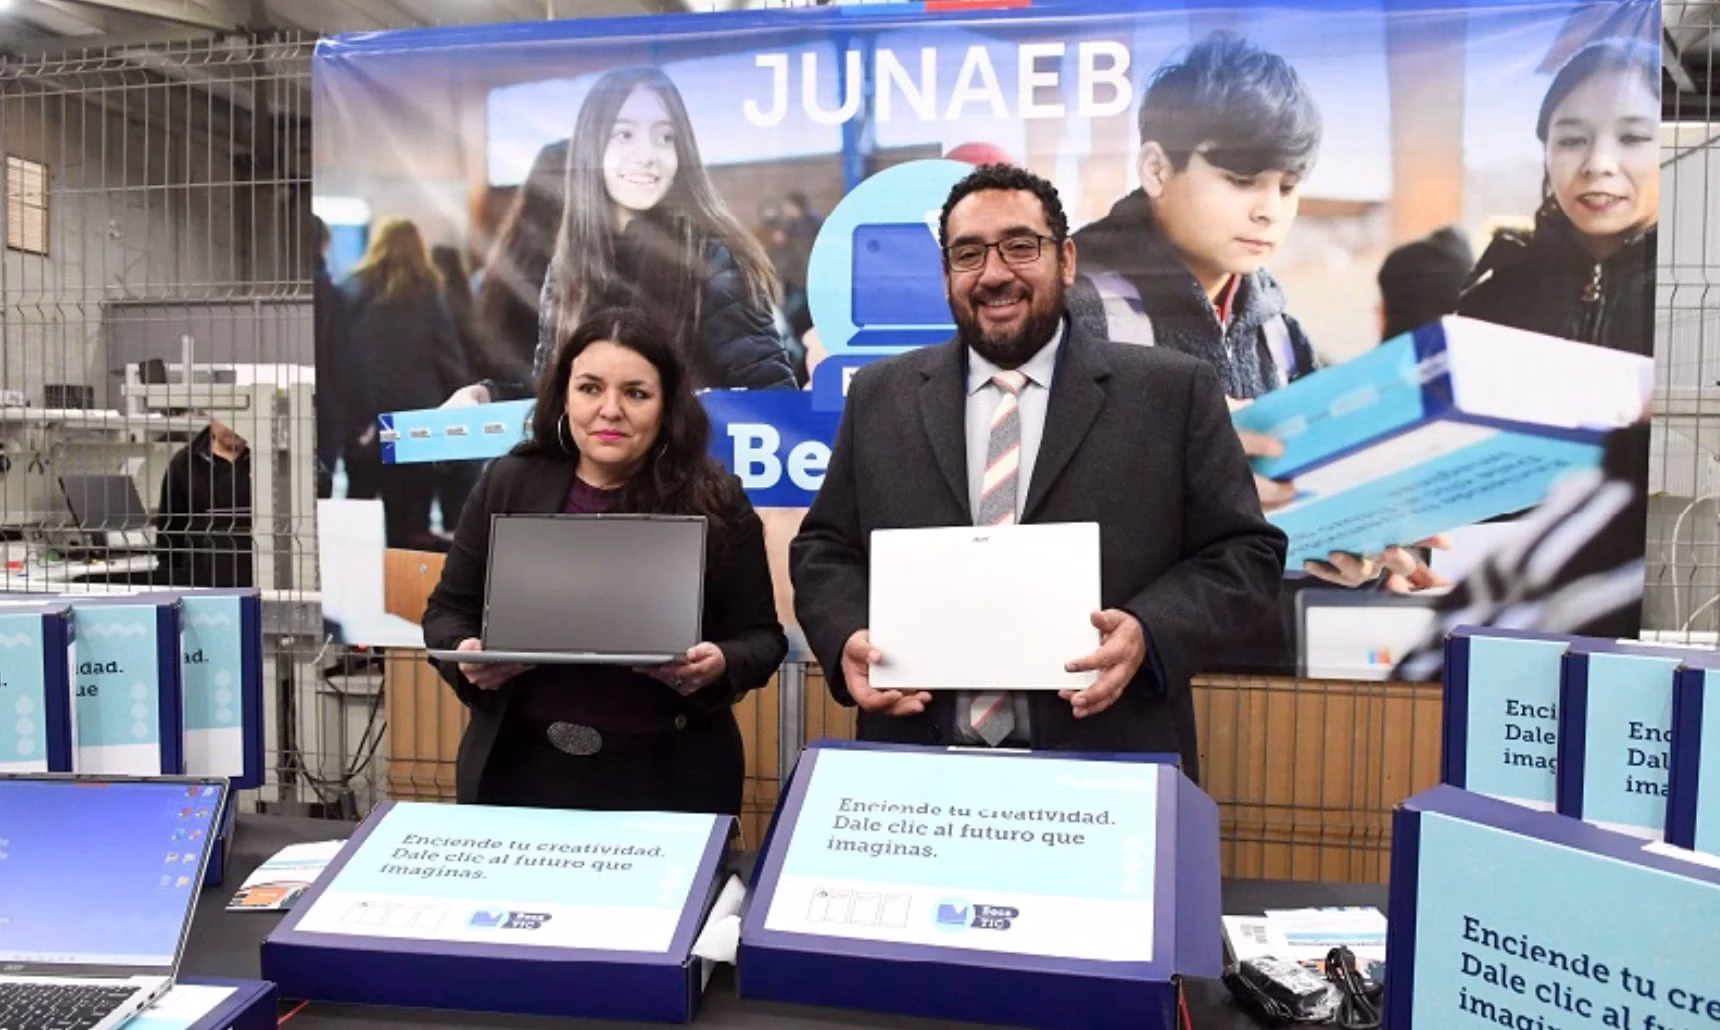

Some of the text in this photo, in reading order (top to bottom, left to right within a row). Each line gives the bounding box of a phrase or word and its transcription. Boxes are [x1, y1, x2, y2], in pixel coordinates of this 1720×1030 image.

[743, 41, 1133, 127] JUNAEB
[1504, 724, 1556, 745] Dale
[1626, 748, 1669, 770] Dal
[949, 805, 971, 817] tu
[832, 815, 1085, 847] Dale clic al futuro que
[401, 833, 665, 858] Enciende tu creatividad.
[827, 836, 938, 858] imaginas.
[379, 863, 487, 879] imaginas.
[391, 847, 633, 873] Dale clic al futuro que
[1462, 914, 1611, 984] Enciende
[1620, 966, 1657, 1001] tu
[1461, 952, 1526, 994] Dale
[1535, 982, 1593, 1018] clic
[1602, 1006, 1632, 1030] al
